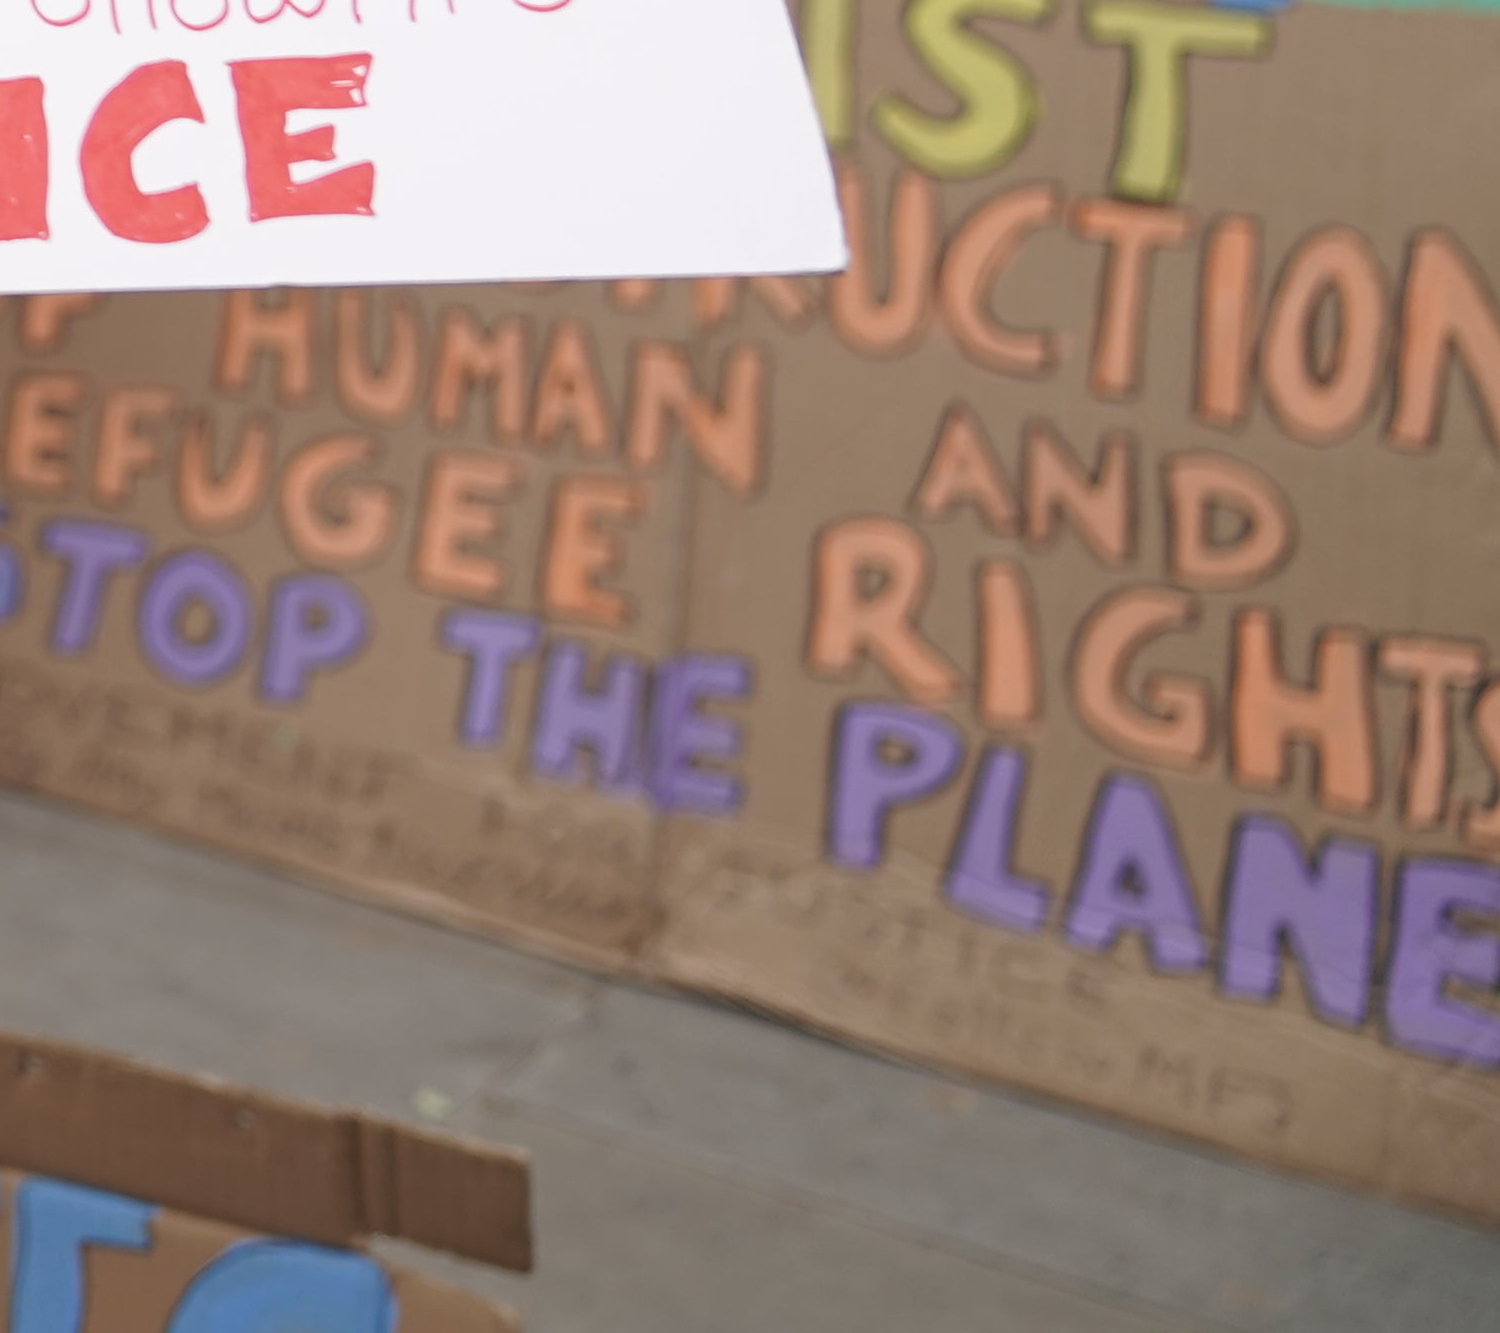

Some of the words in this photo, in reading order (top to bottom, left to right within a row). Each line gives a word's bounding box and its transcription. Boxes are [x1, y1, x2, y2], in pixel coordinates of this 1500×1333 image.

[212, 283, 770, 499] HUMAN
[914, 396, 1296, 593] AND
[440, 608, 758, 821] THE
[826, 695, 1500, 1077] PLANE
